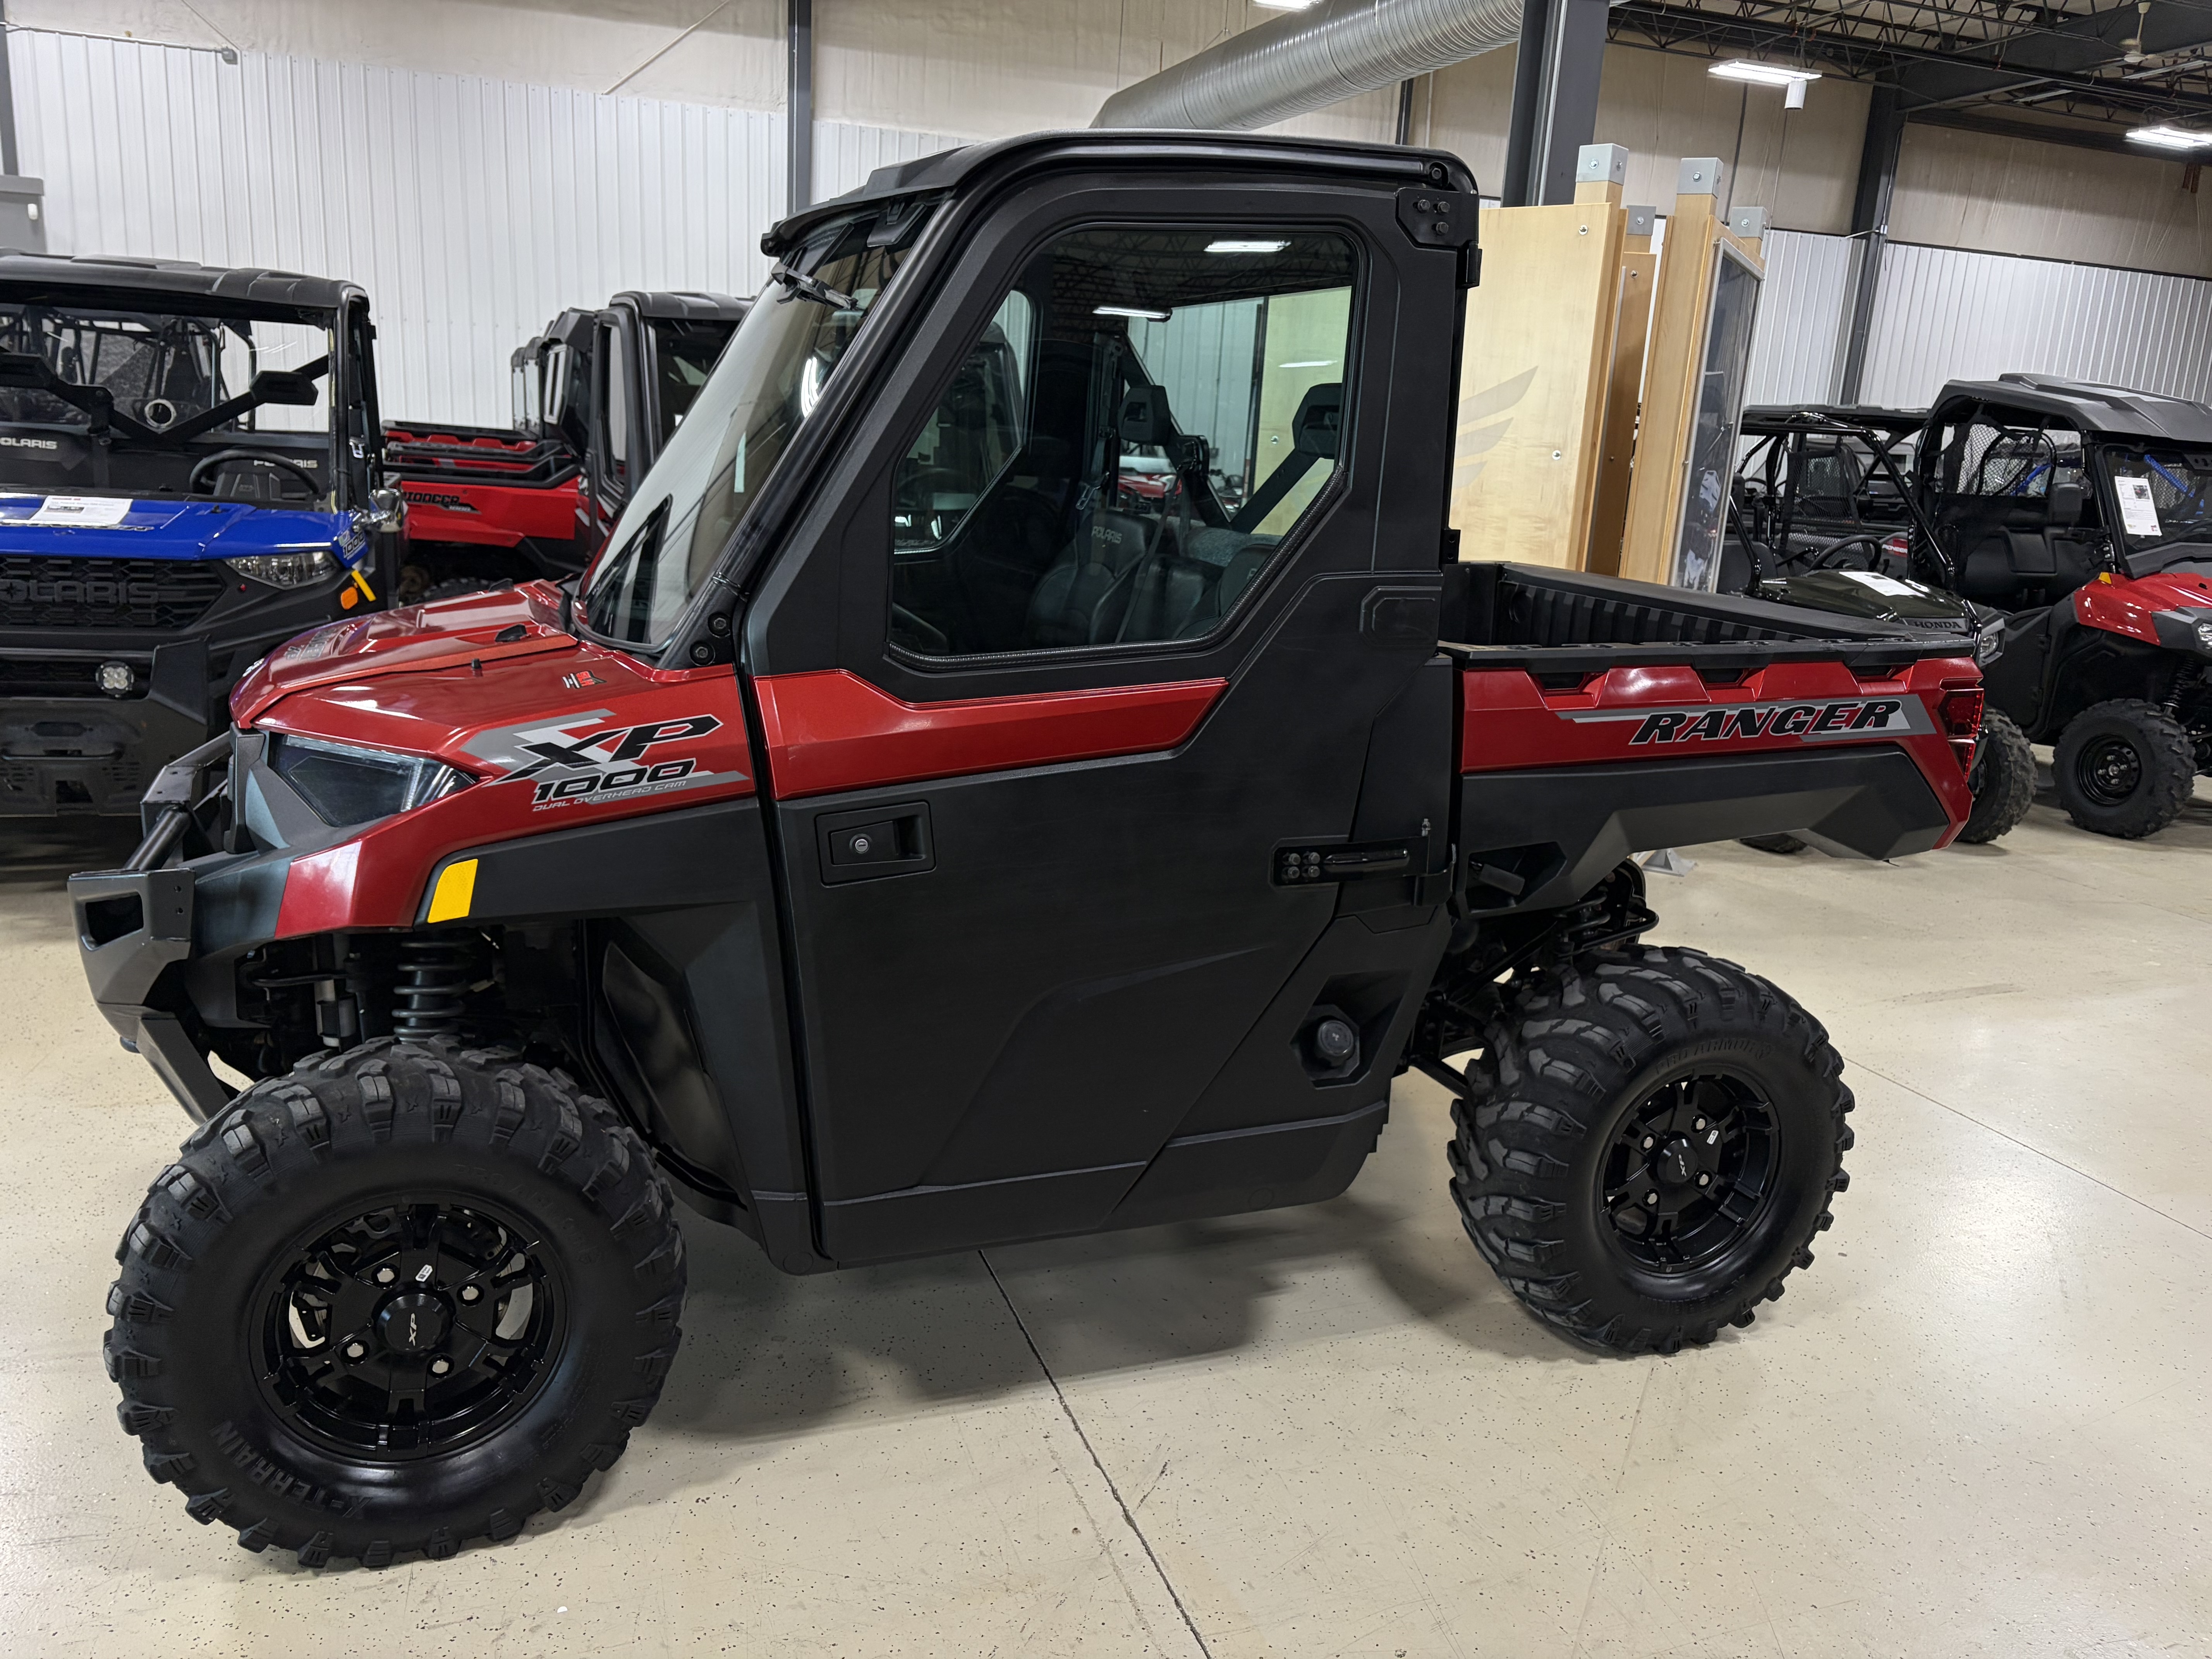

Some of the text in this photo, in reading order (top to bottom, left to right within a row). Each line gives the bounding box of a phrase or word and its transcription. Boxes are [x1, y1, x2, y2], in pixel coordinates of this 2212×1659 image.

[0, 437, 58, 450] OLARIS
[1091, 526, 1122, 544] POLARIS
[0, 579, 158, 604] OLARIS
[1628, 699, 1902, 745] RANGER
[483, 713, 724, 788] XP
[531, 758, 697, 804] 1000
[532, 780, 687, 812] DUAL OVERHEAD CAM
[1678, 1154, 1687, 1176] XP
[409, 1313, 417, 1346] XP
